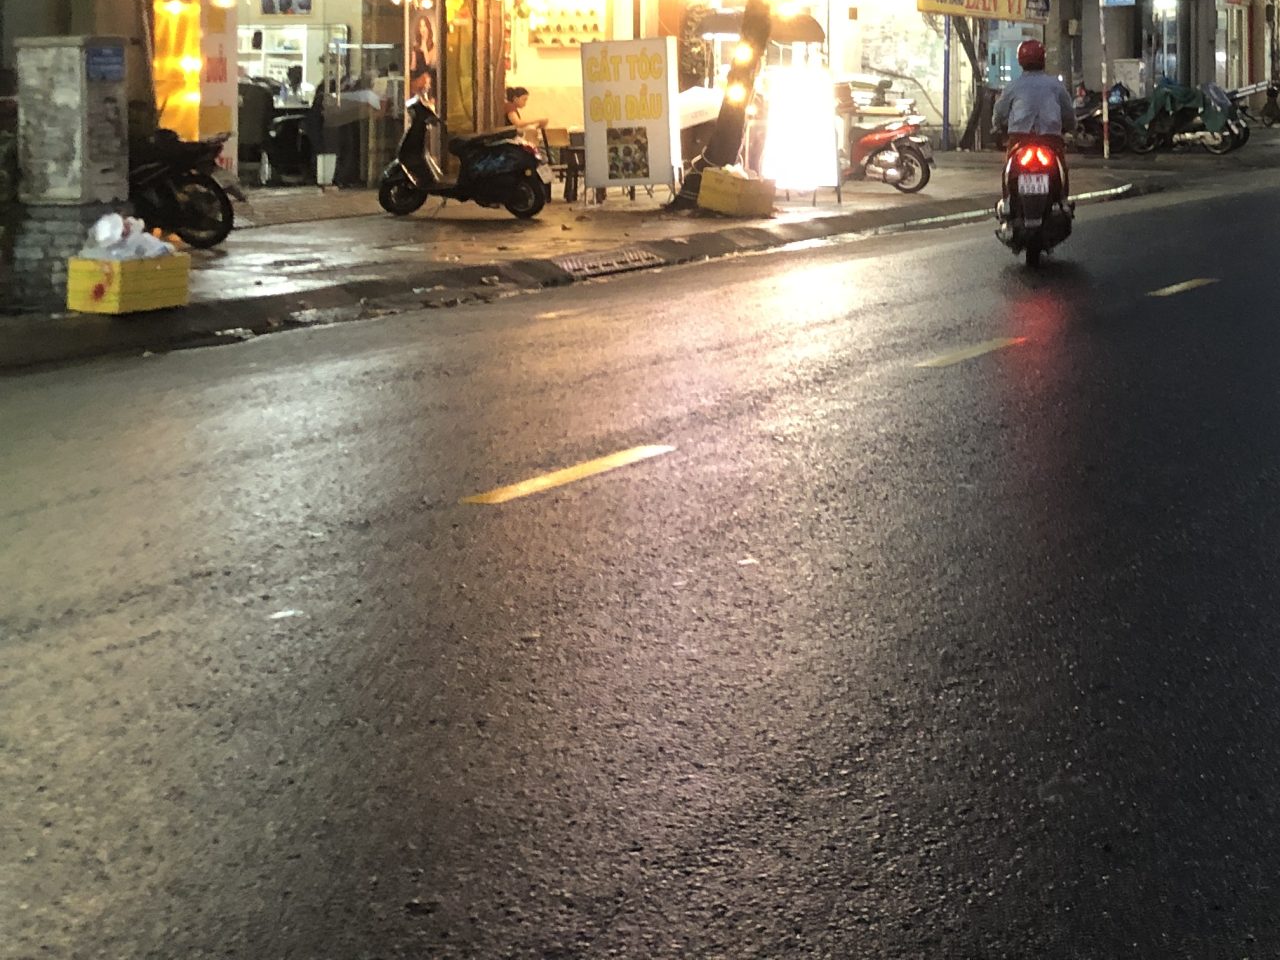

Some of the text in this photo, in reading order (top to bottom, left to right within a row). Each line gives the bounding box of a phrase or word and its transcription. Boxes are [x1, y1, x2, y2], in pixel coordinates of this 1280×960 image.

[586, 47, 663, 83] CẮT TÓC
[589, 83, 663, 129] GỘI ĐẦU
